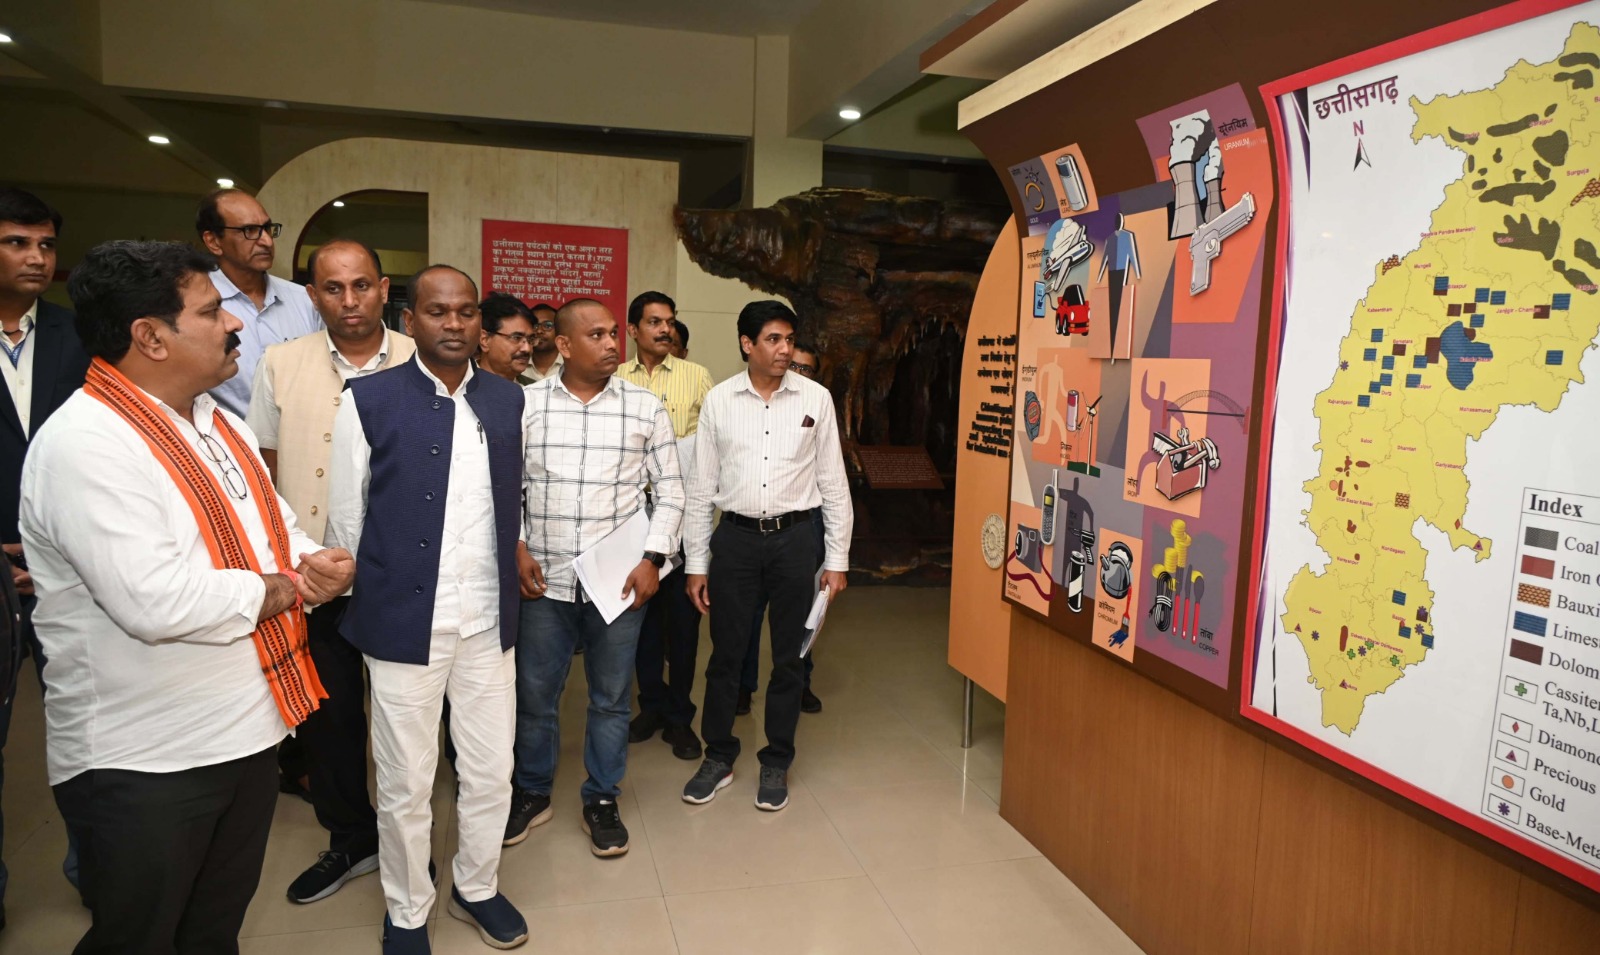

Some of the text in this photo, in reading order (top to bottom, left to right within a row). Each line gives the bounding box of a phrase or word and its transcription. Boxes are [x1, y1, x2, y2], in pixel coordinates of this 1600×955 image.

[1312, 75, 1398, 120] छत्तीसगढ़
[1353, 120, 1364, 136] N
[1223, 137, 1250, 151] URANIUM
[1566, 168, 1589, 176] Surguja
[553, 242, 562, 250] को
[565, 244, 576, 252] एक
[567, 253, 585, 261] करता
[1529, 494, 1584, 518] Index
[1564, 536, 1600, 556] Coal
[1560, 566, 1591, 585] Iron
[1553, 623, 1600, 649] Limes
[1199, 642, 1219, 656] COPPER
[1534, 758, 1597, 795] Precious
[1530, 786, 1566, 812] Gold
